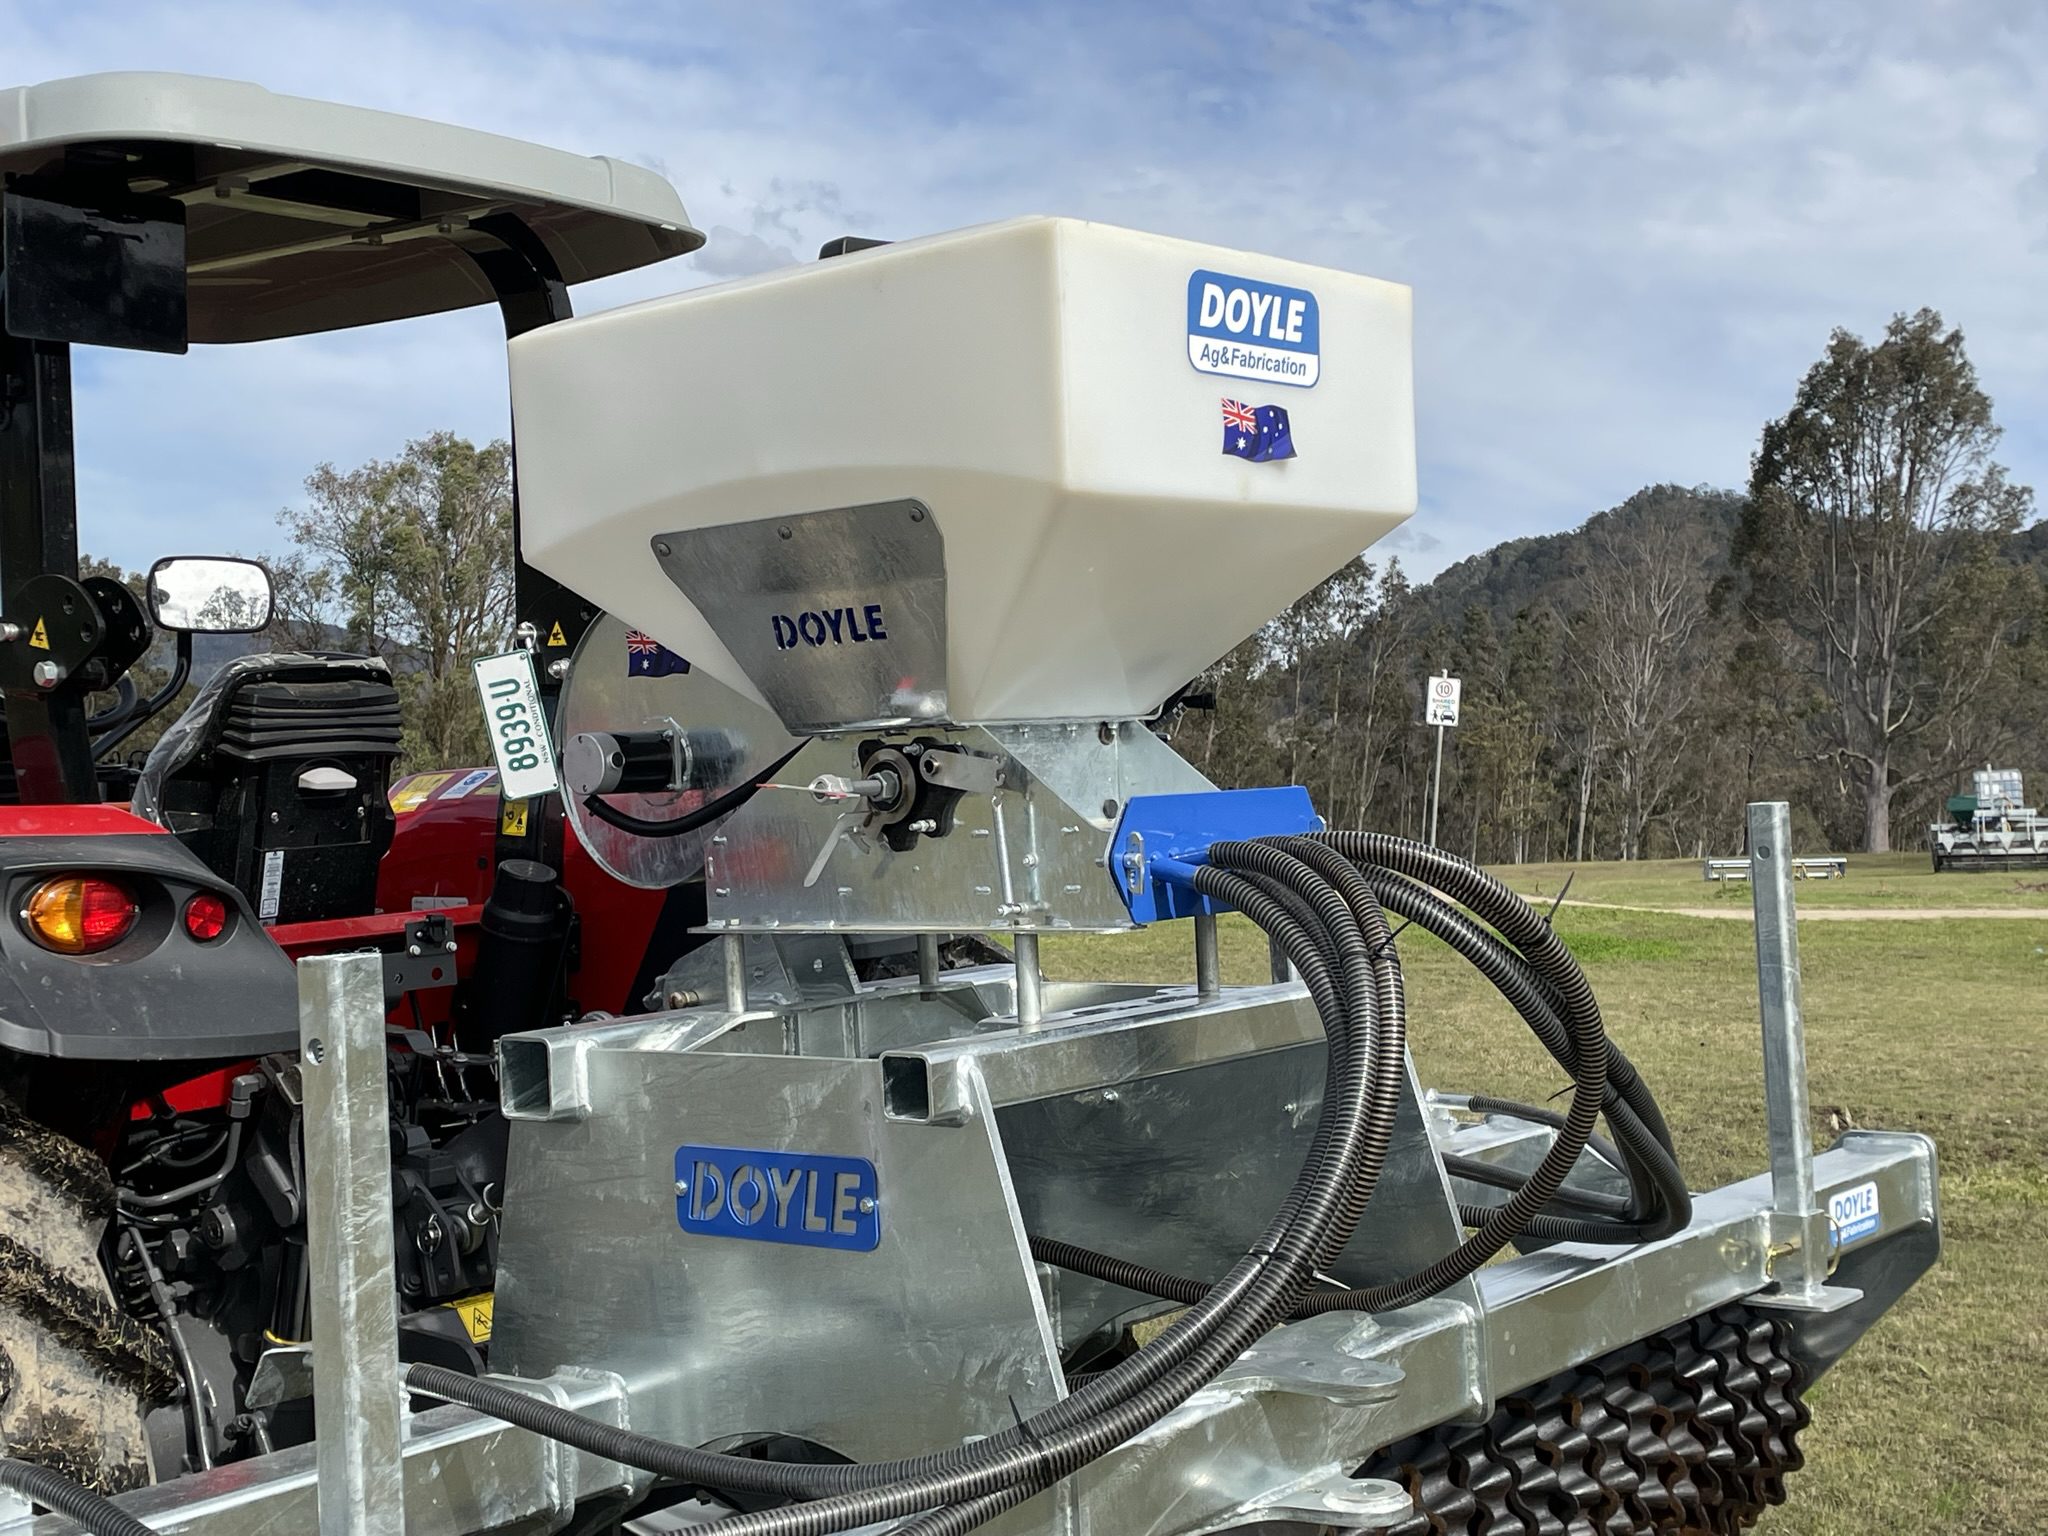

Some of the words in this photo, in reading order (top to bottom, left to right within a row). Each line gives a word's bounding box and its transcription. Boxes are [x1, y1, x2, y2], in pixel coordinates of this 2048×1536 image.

[1200, 282, 1306, 343] DOYLE
[1200, 343, 1307, 377] Ag&Fabrication
[771, 604, 888, 650] DOYLE
[523, 679, 544, 738] CONDITIONAL
[1439, 684, 1450, 695] 10
[688, 1161, 861, 1236] DOYLE
[1835, 1188, 1872, 1222] DOYLE
